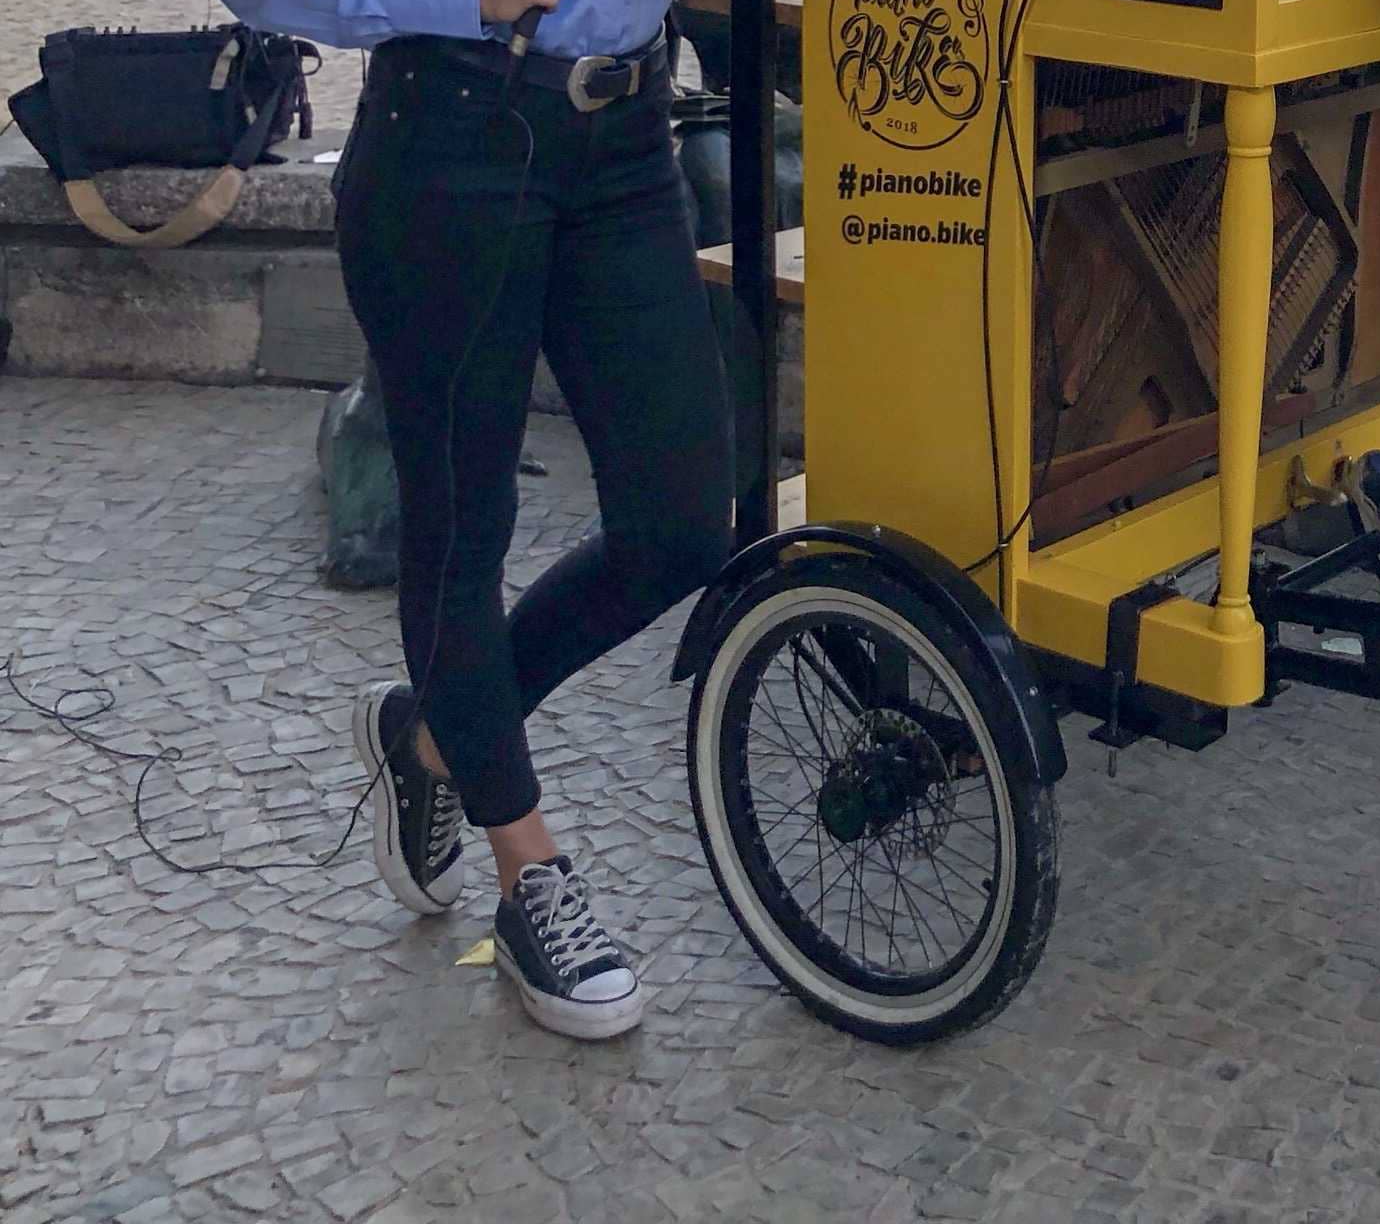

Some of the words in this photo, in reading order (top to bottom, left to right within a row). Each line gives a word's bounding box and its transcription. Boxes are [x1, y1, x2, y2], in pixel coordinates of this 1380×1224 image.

[836, 8, 984, 121] Bike
[886, 117, 918, 134] 2018
[838, 164, 982, 199] #pianobike
[842, 214, 986, 246] @piano.bike
